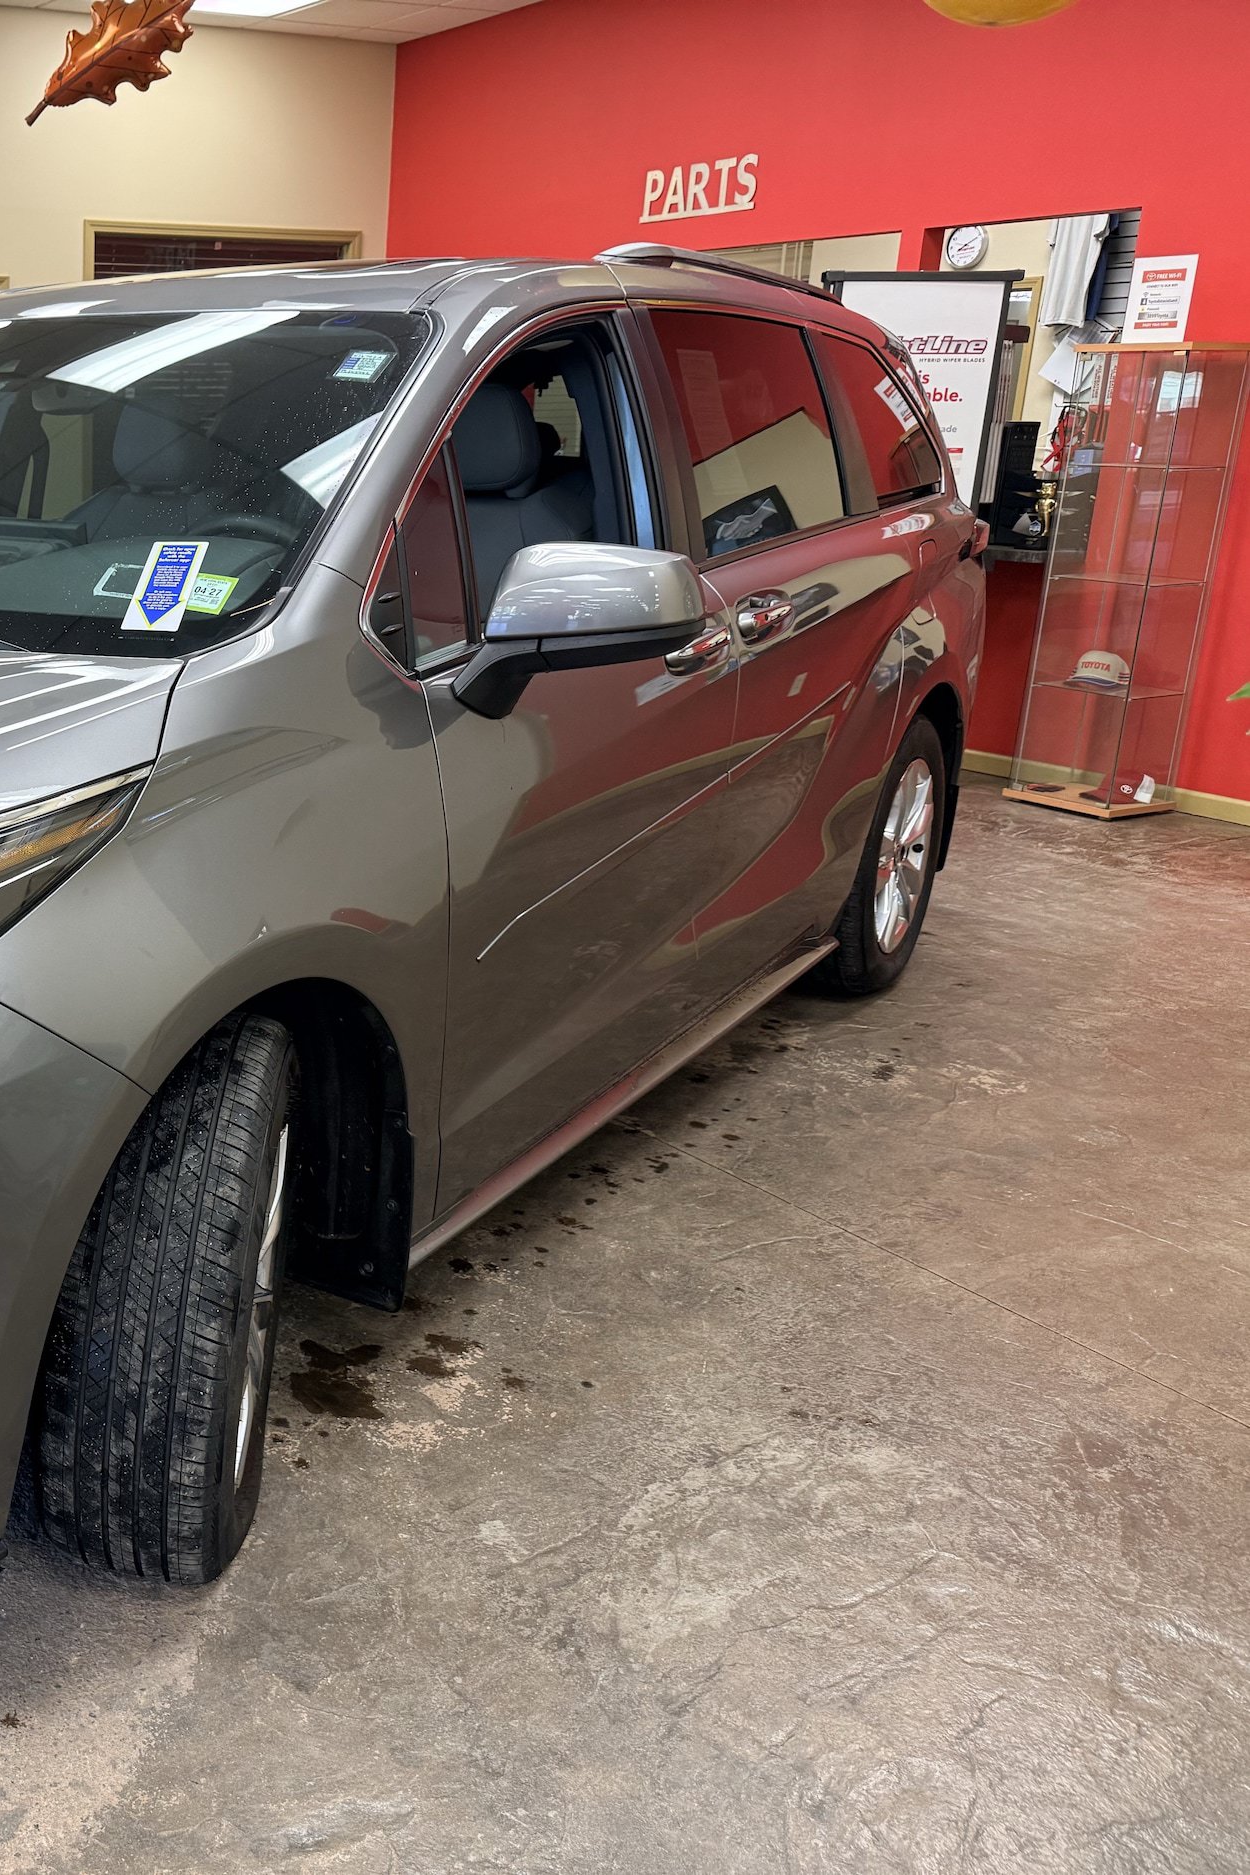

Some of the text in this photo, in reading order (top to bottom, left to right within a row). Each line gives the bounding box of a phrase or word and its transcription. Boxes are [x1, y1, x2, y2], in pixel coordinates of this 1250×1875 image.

[641, 153, 759, 218] PARTS
[194, 586, 223, 597] 04 27
[1081, 661, 1111, 672] TOYOTA
